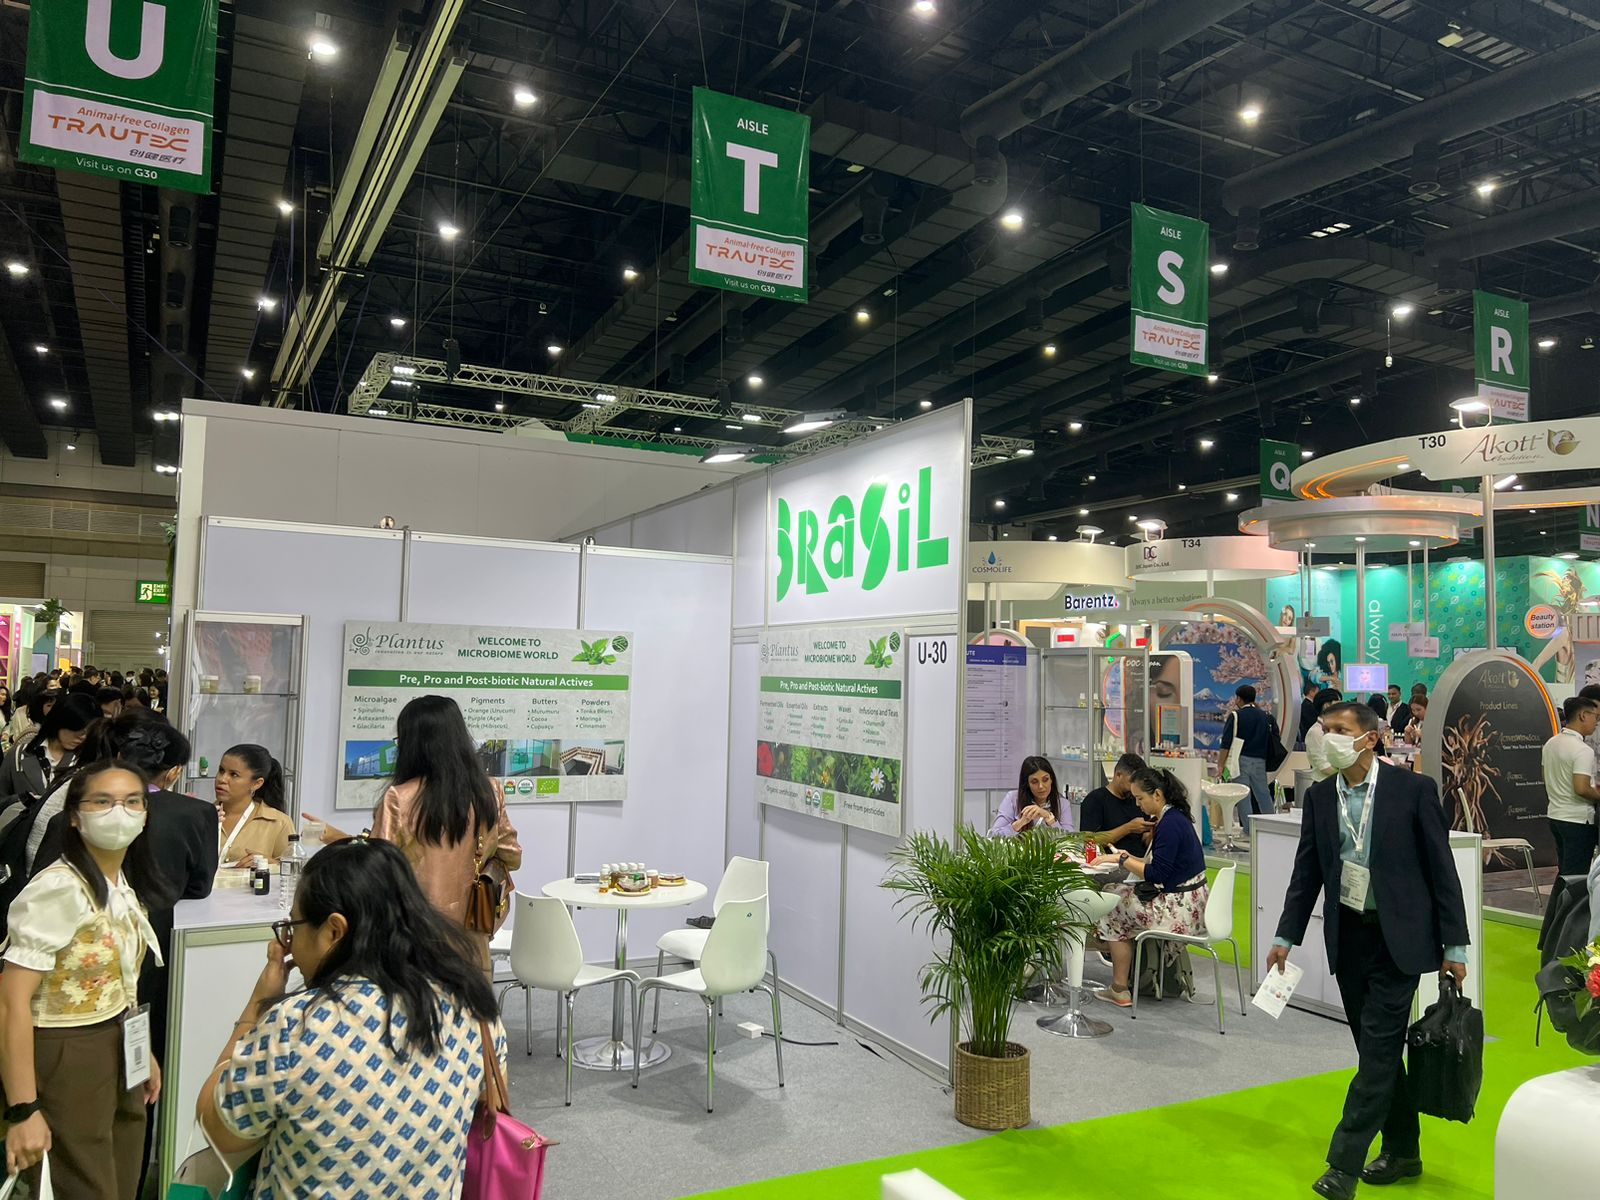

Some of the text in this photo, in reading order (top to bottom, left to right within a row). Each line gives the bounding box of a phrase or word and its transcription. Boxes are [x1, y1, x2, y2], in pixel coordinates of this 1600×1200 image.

[85, 0, 166, 79] U
[77, 106, 190, 135] Animal-free Collagen
[736, 117, 769, 136] AISLE
[48, 114, 189, 152] TRAUTEC
[76, 157, 158, 180] Visit us on G30
[726, 141, 779, 215] T
[1160, 226, 1182, 240] AISLE
[724, 237, 795, 258] Animal-free Collagen
[706, 243, 795, 271] TRAUTEC
[724, 278, 739, 288] Visit
[760, 285, 776, 293] G30
[1156, 250, 1186, 305] S
[1493, 307, 1510, 319] AISLE
[1142, 330, 1201, 351] TRAUTEC
[1490, 325, 1515, 376] R
[1418, 434, 1446, 450] T30
[1460, 432, 1544, 465] Akott
[1270, 461, 1290, 491] Q
[1181, 539, 1202, 548] T34
[375, 633, 445, 651] Plantus
[478, 637, 541, 647] WELCOME TO
[813, 641, 847, 650] WELCOME TO
[457, 649, 559, 660] MICROBIOME WORLD
[770, 644, 799, 657] Plantus
[804, 654, 857, 663] MICROBIOME WORLD
[918, 640, 947, 665] U-30
[399, 674, 594, 687] Pre, Pro and Post-biotic Natural Actives
[780, 680, 879, 694] Pre, Pro and Post-biotic Natural Actives
[354, 696, 398, 705] Microalgae
[471, 697, 506, 706] Pigments
[813, 703, 828, 711] Extracts
[1480, 701, 1519, 711] Product Lines
[859, 706, 899, 718] Infusions and Teas
[843, 800, 885, 817] Free from pesticides
